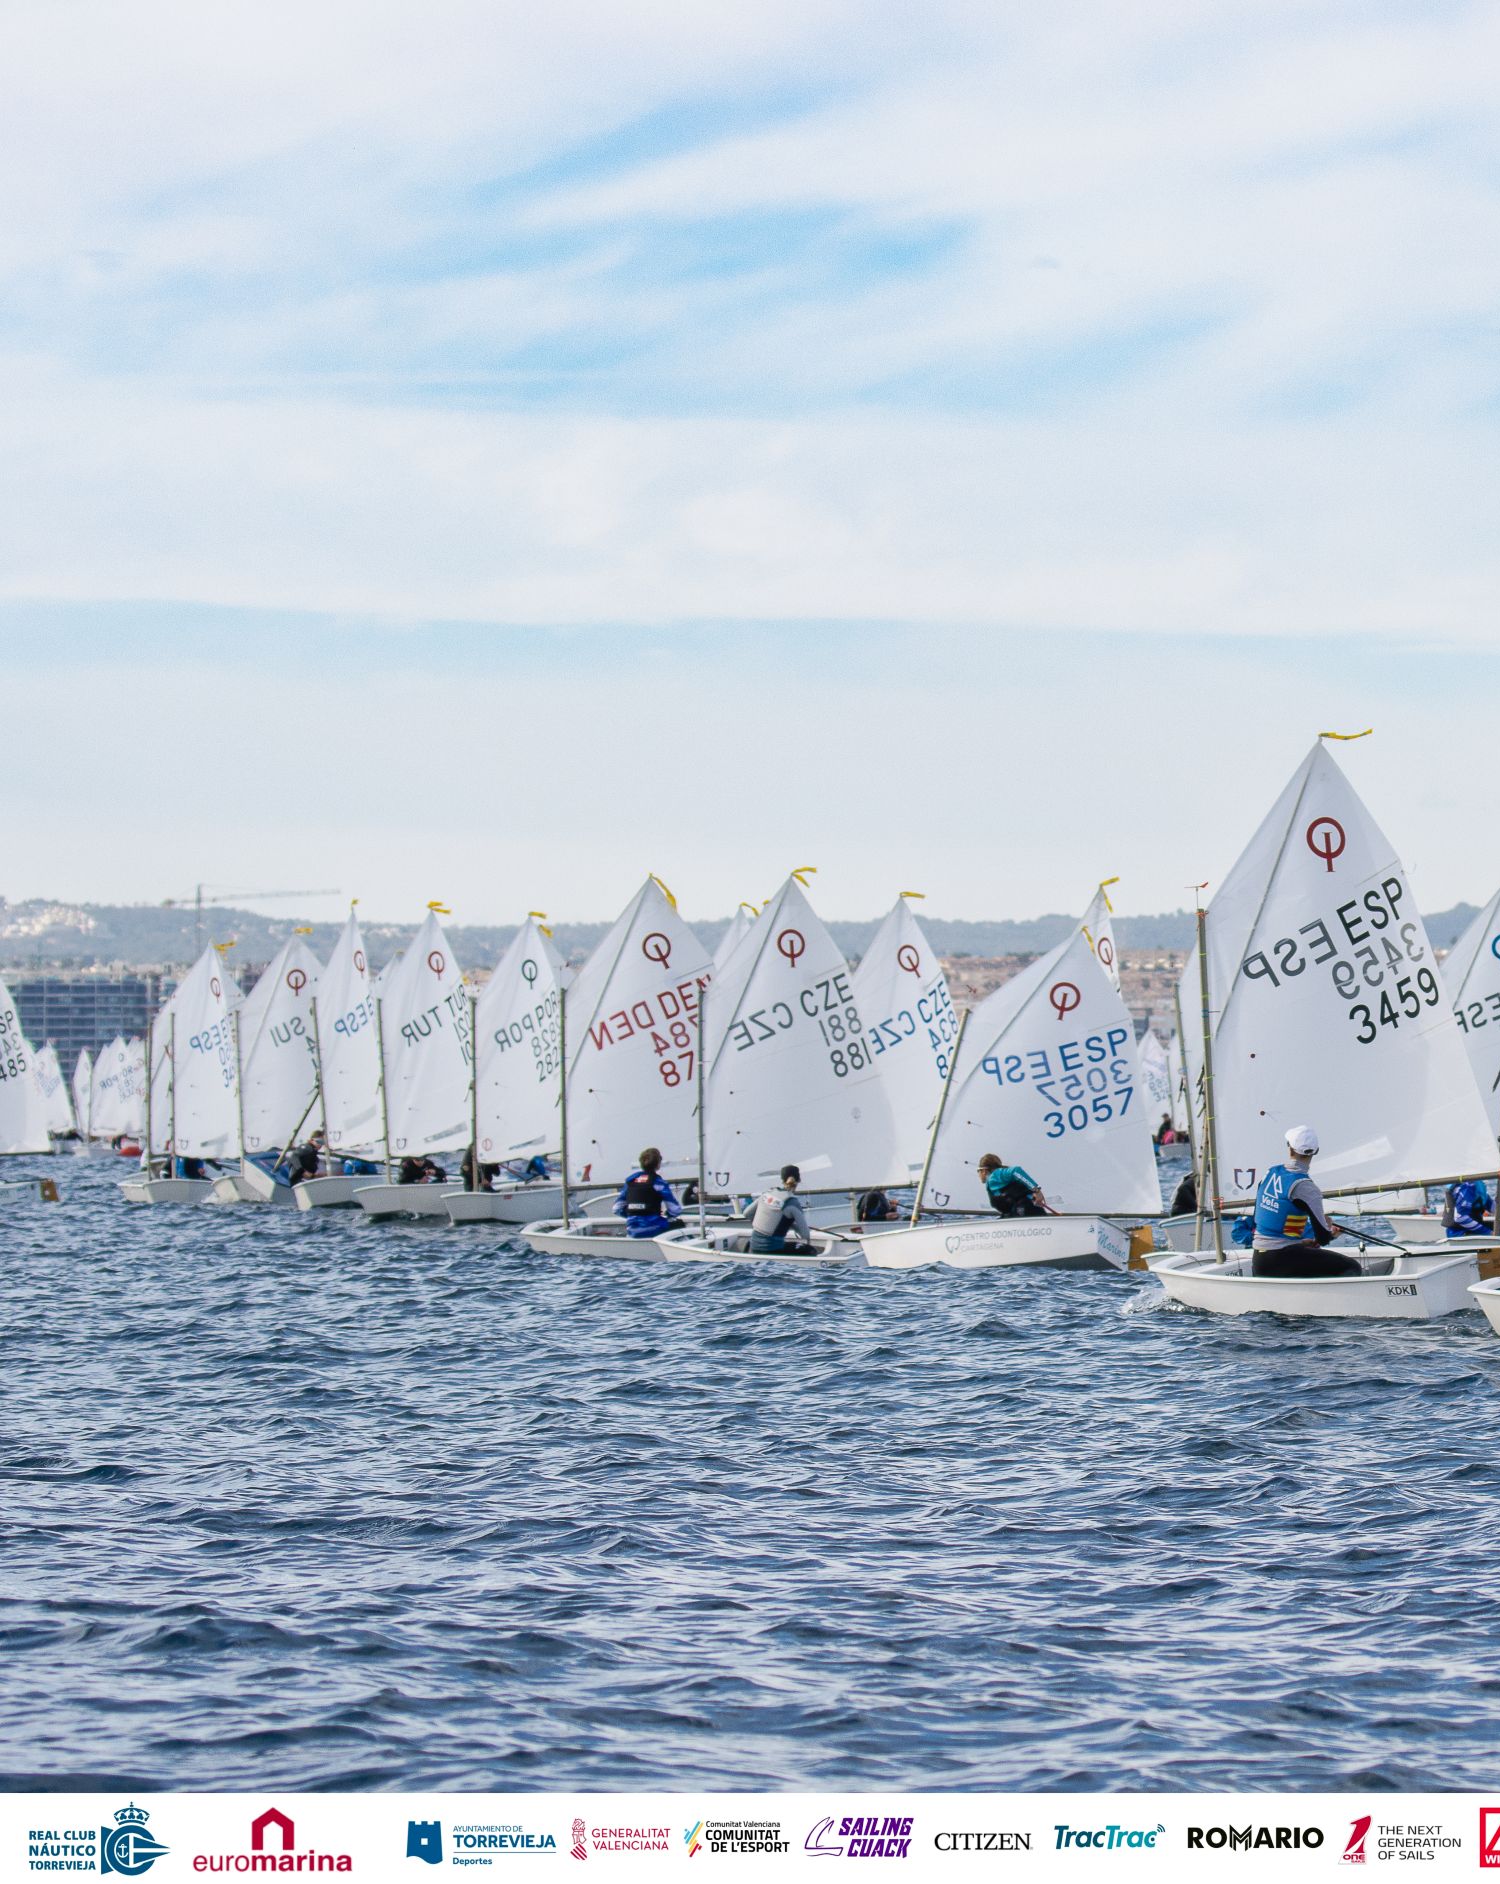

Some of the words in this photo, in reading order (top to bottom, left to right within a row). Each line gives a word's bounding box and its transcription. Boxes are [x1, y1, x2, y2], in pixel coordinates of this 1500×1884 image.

[1336, 877, 1402, 945] ESP
[444, 984, 467, 1017] TUR
[799, 972, 853, 1017] CZE
[916, 981, 950, 1024] CZE
[1349, 967, 1439, 1044] 3459
[830, 1037, 872, 1078] 881
[1059, 1028, 1128, 1072] ESP
[1043, 1086, 1134, 1138] 3057
[960, 1232, 990, 1242] CENTRO
[1387, 1286, 1410, 1296] KDK
